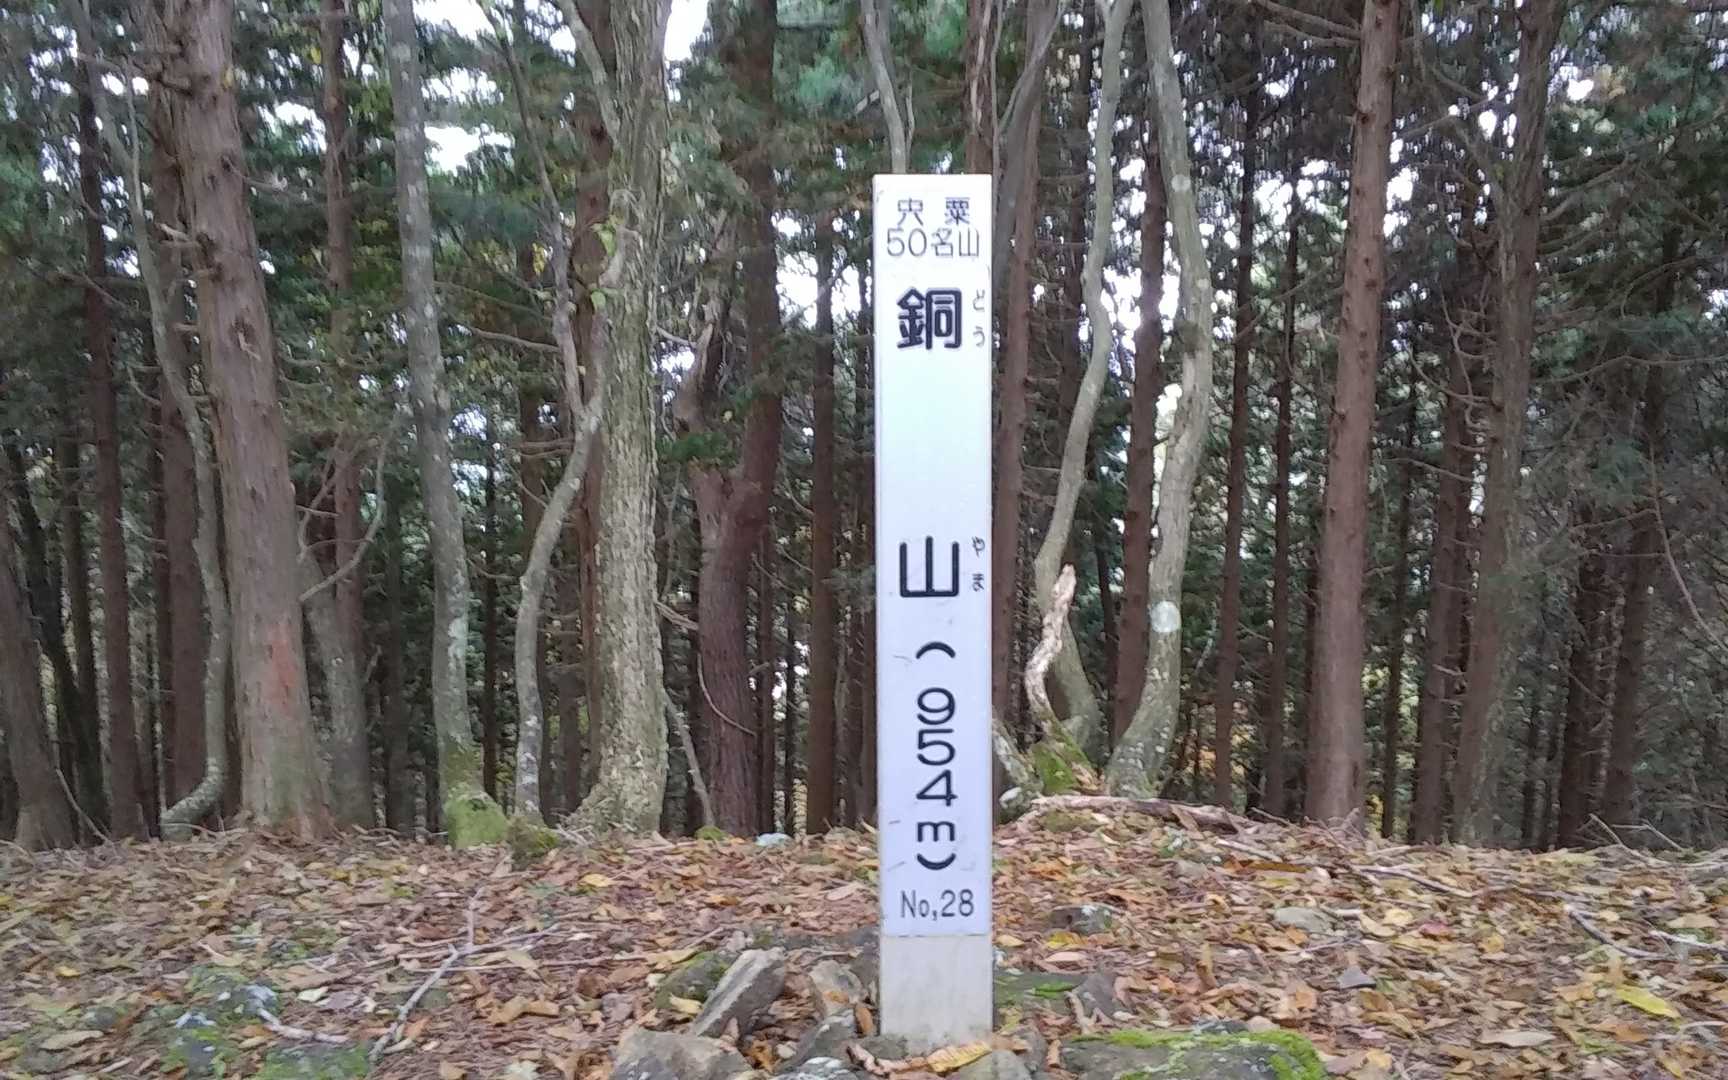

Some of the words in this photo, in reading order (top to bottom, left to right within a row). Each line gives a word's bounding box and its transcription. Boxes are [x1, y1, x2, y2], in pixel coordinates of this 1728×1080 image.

[887, 227, 980, 257] 50名山
[972, 288, 986, 348] とう
[972, 536, 986, 592] やま
